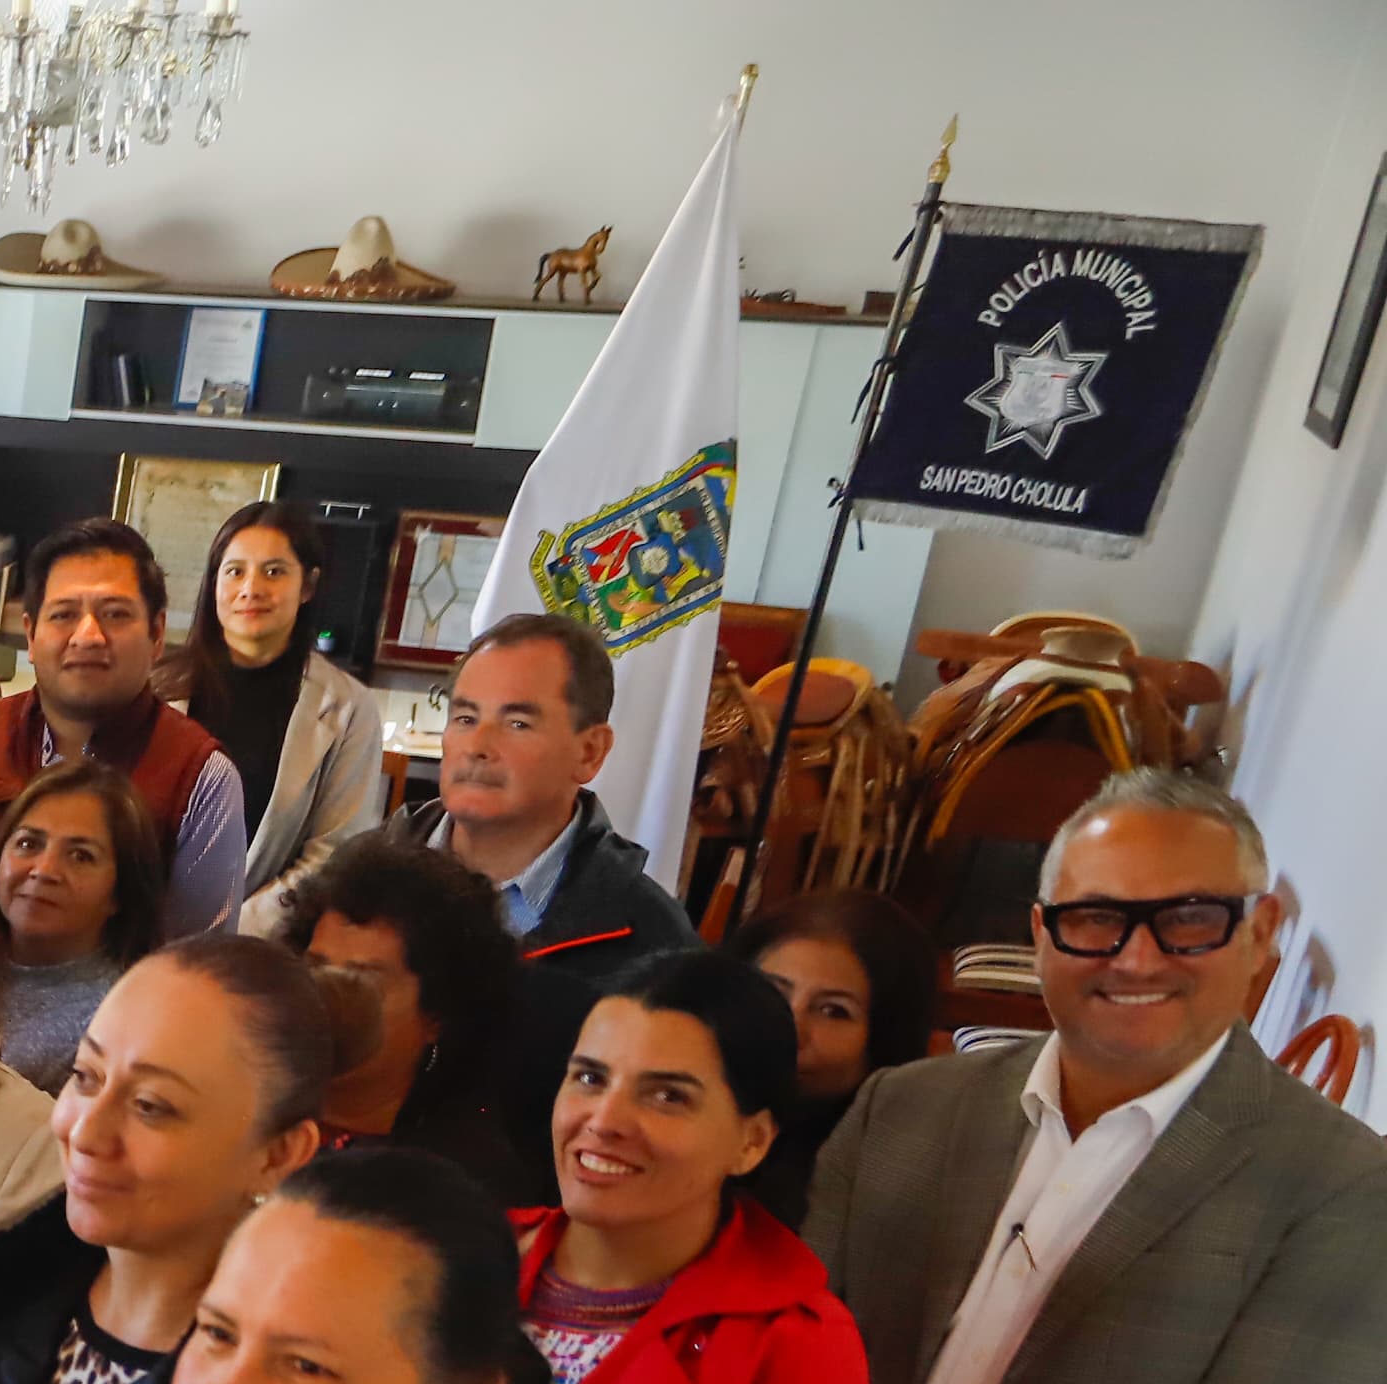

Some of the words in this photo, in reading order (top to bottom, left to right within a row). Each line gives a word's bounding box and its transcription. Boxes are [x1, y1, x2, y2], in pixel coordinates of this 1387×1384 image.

[977, 250, 1066, 327] POLICÍA
[1071, 249, 1158, 340] MUNICIPAL
[920, 465, 957, 492] SAN
[954, 469, 1011, 500] PEDRO
[1011, 478, 1088, 514] CHOLULA
